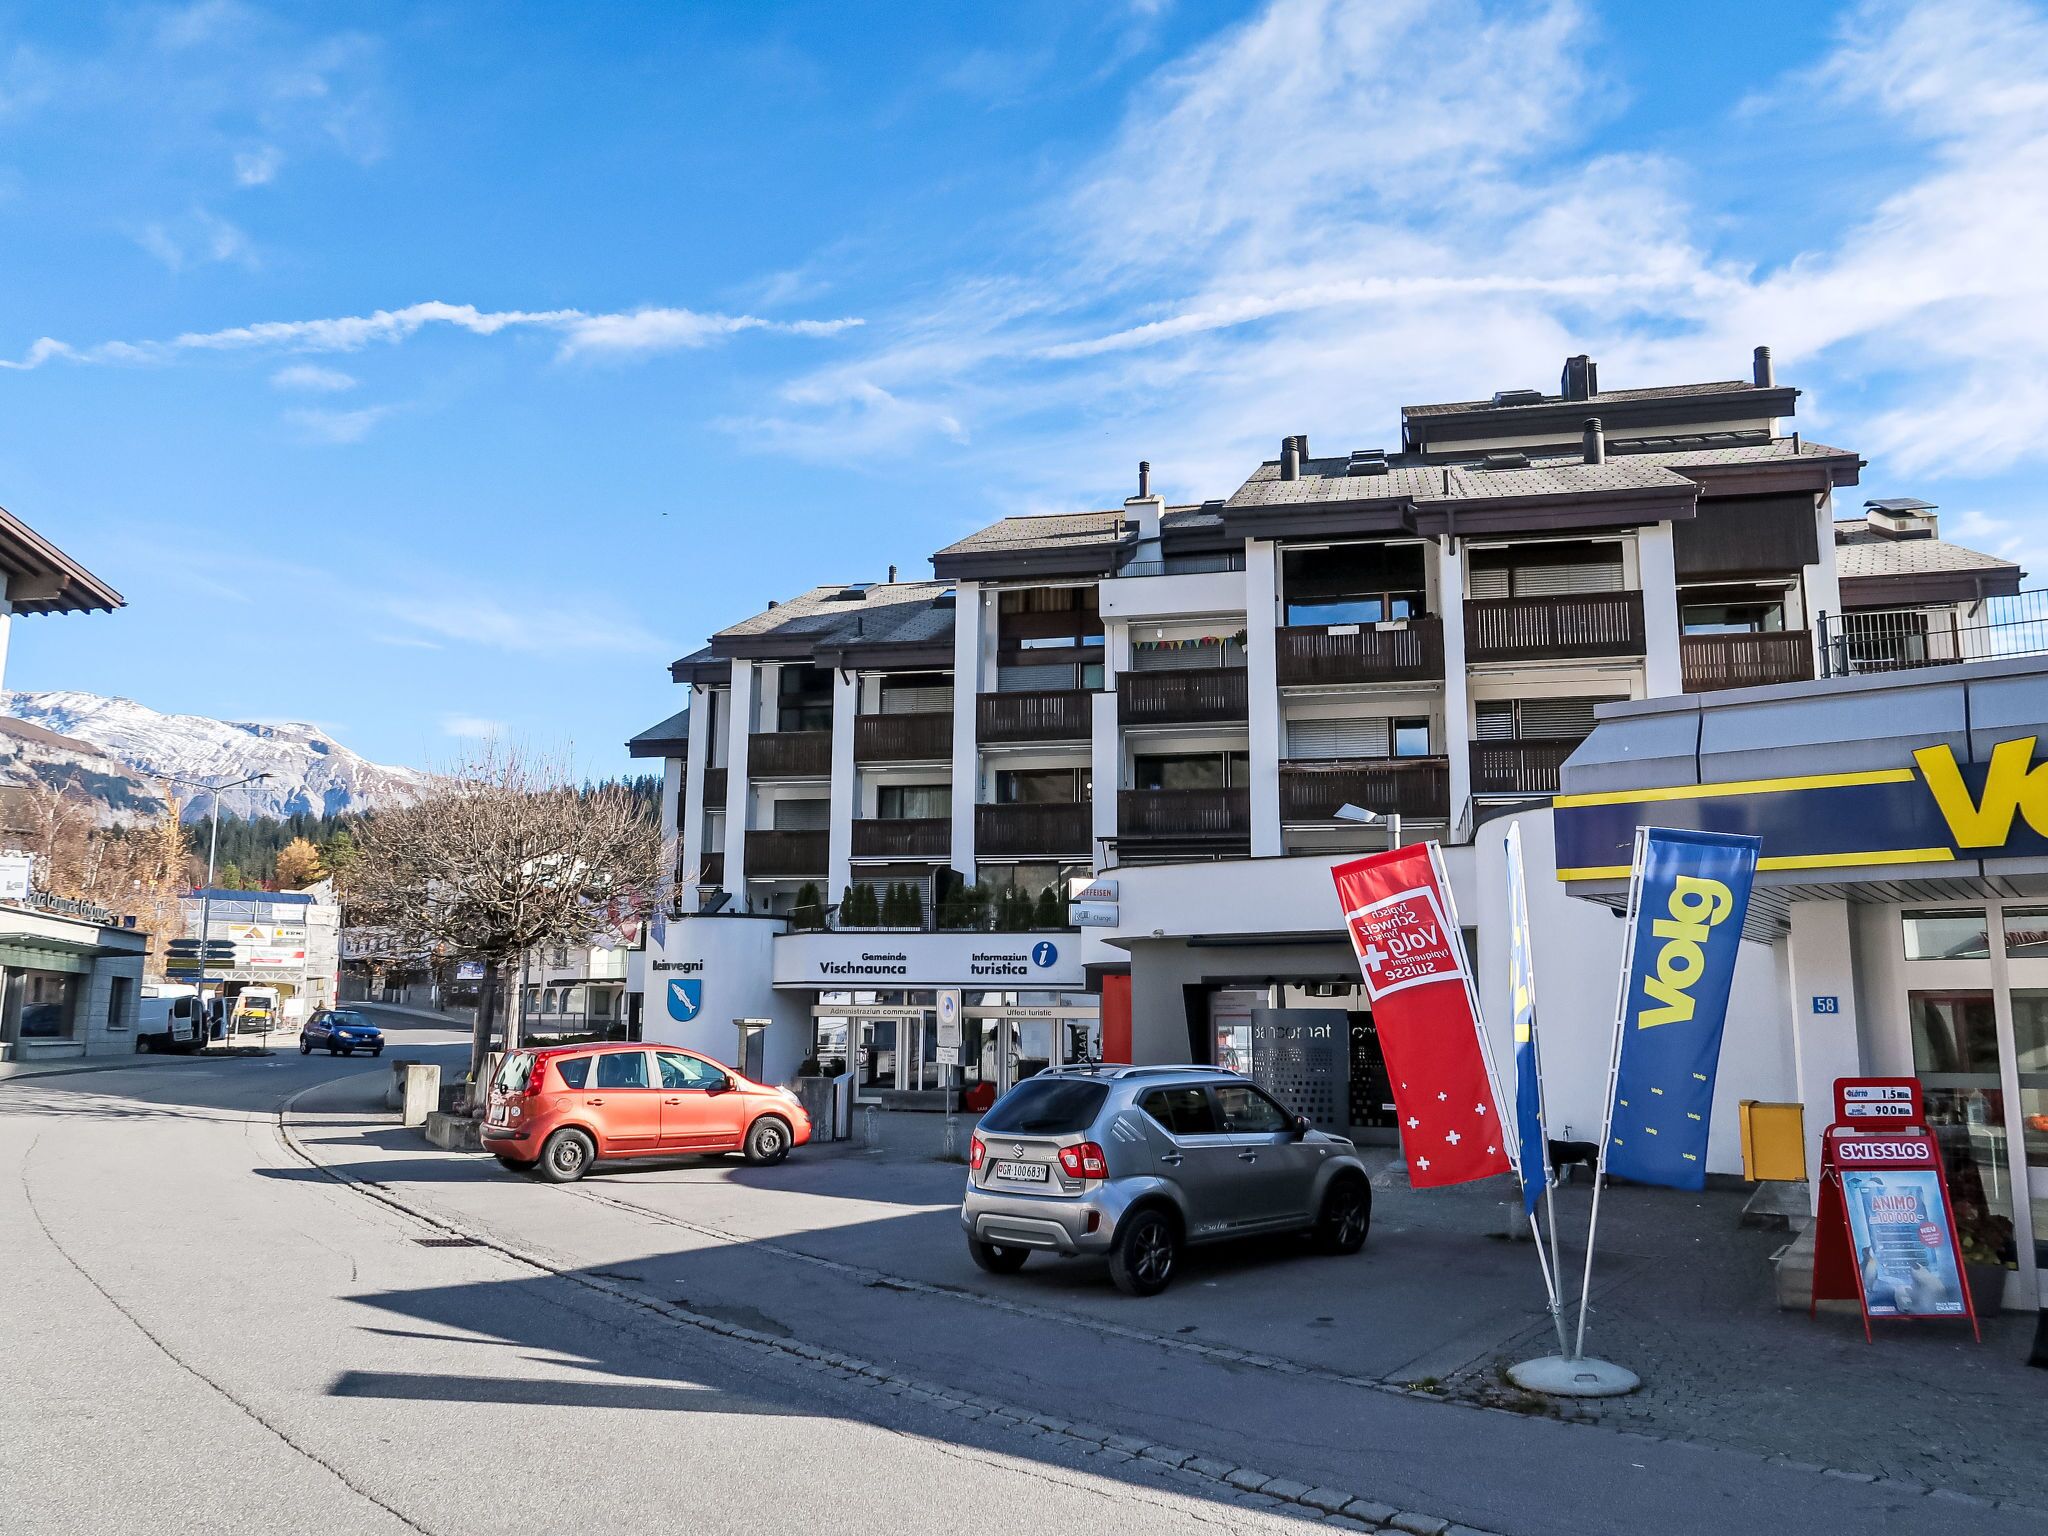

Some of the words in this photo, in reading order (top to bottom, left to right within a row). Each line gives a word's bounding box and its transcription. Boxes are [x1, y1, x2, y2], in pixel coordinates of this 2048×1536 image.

[861, 952, 907, 961] Gemeinde
[972, 953, 1028, 961] Informaziun
[1638, 875, 1733, 1030] Volg
[652, 959, 704, 974] Beinvegni
[820, 961, 907, 974] Vischnaunca
[970, 962, 1028, 975] turistica
[1817, 998, 1835, 1012] 58
[1840, 1143, 1928, 1159] SWISSLOS
[1872, 1195, 1917, 1212] ANIMO
